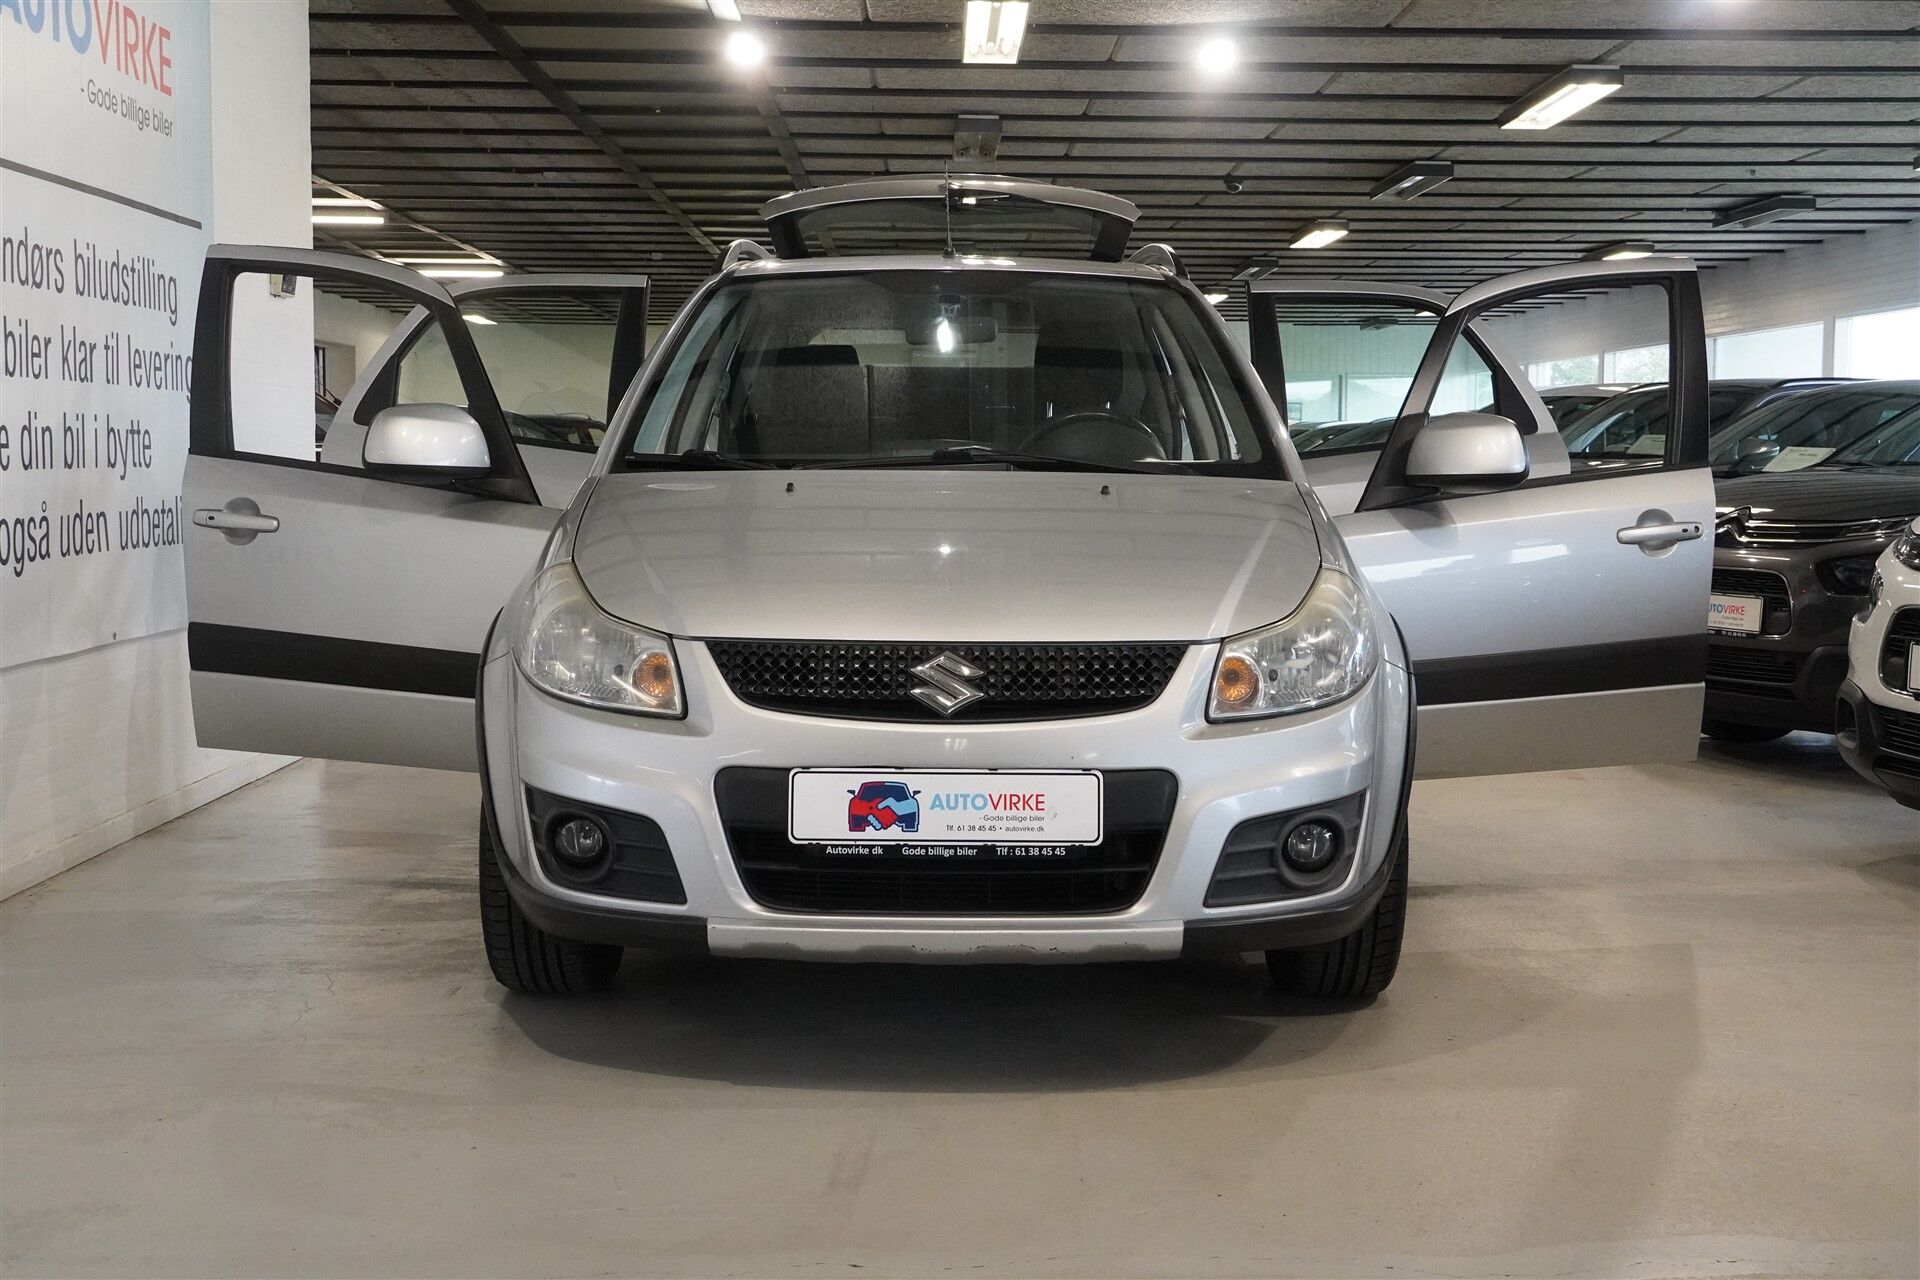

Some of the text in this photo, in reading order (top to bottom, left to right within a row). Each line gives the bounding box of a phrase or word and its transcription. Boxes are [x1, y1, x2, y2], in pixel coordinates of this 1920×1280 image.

[88, 79, 118, 113] Gode
[121, 93, 150, 131] billige
[153, 108, 173, 138] biler
[3, 226, 178, 326] ndørs biludstilling
[3, 315, 51, 379] biler
[61, 324, 97, 383] klar
[104, 331, 119, 385] til
[20, 410, 53, 471] din
[63, 412, 86, 470] bil
[94, 414, 98, 468] i
[106, 414, 152, 481] bytte
[0, 500, 50, 578] også
[60, 499, 110, 558] uden
[929, 793, 1045, 811] AUTOVIRKE
[957, 824, 965, 832] 61
[967, 824, 976, 832] 38
[977, 824, 987, 832] 45
[988, 824, 997, 832] 45
[1005, 824, 1045, 832] autovirke.dk
[983, 814, 1004, 822] Gode
[1005, 814, 1028, 823] billige
[1029, 814, 1045, 822] biler
[826, 845, 870, 855] Autovirke
[871, 845, 884, 855] dk
[902, 846, 926, 856] Gode
[928, 846, 955, 858] billige
[957, 847, 978, 856] biler
[996, 847, 1009, 856] Tlf
[1015, 847, 1026, 856] 61
[1028, 847, 1040, 856] 38
[1041, 847, 1053, 856] 45
[1054, 847, 1066, 856] 45
